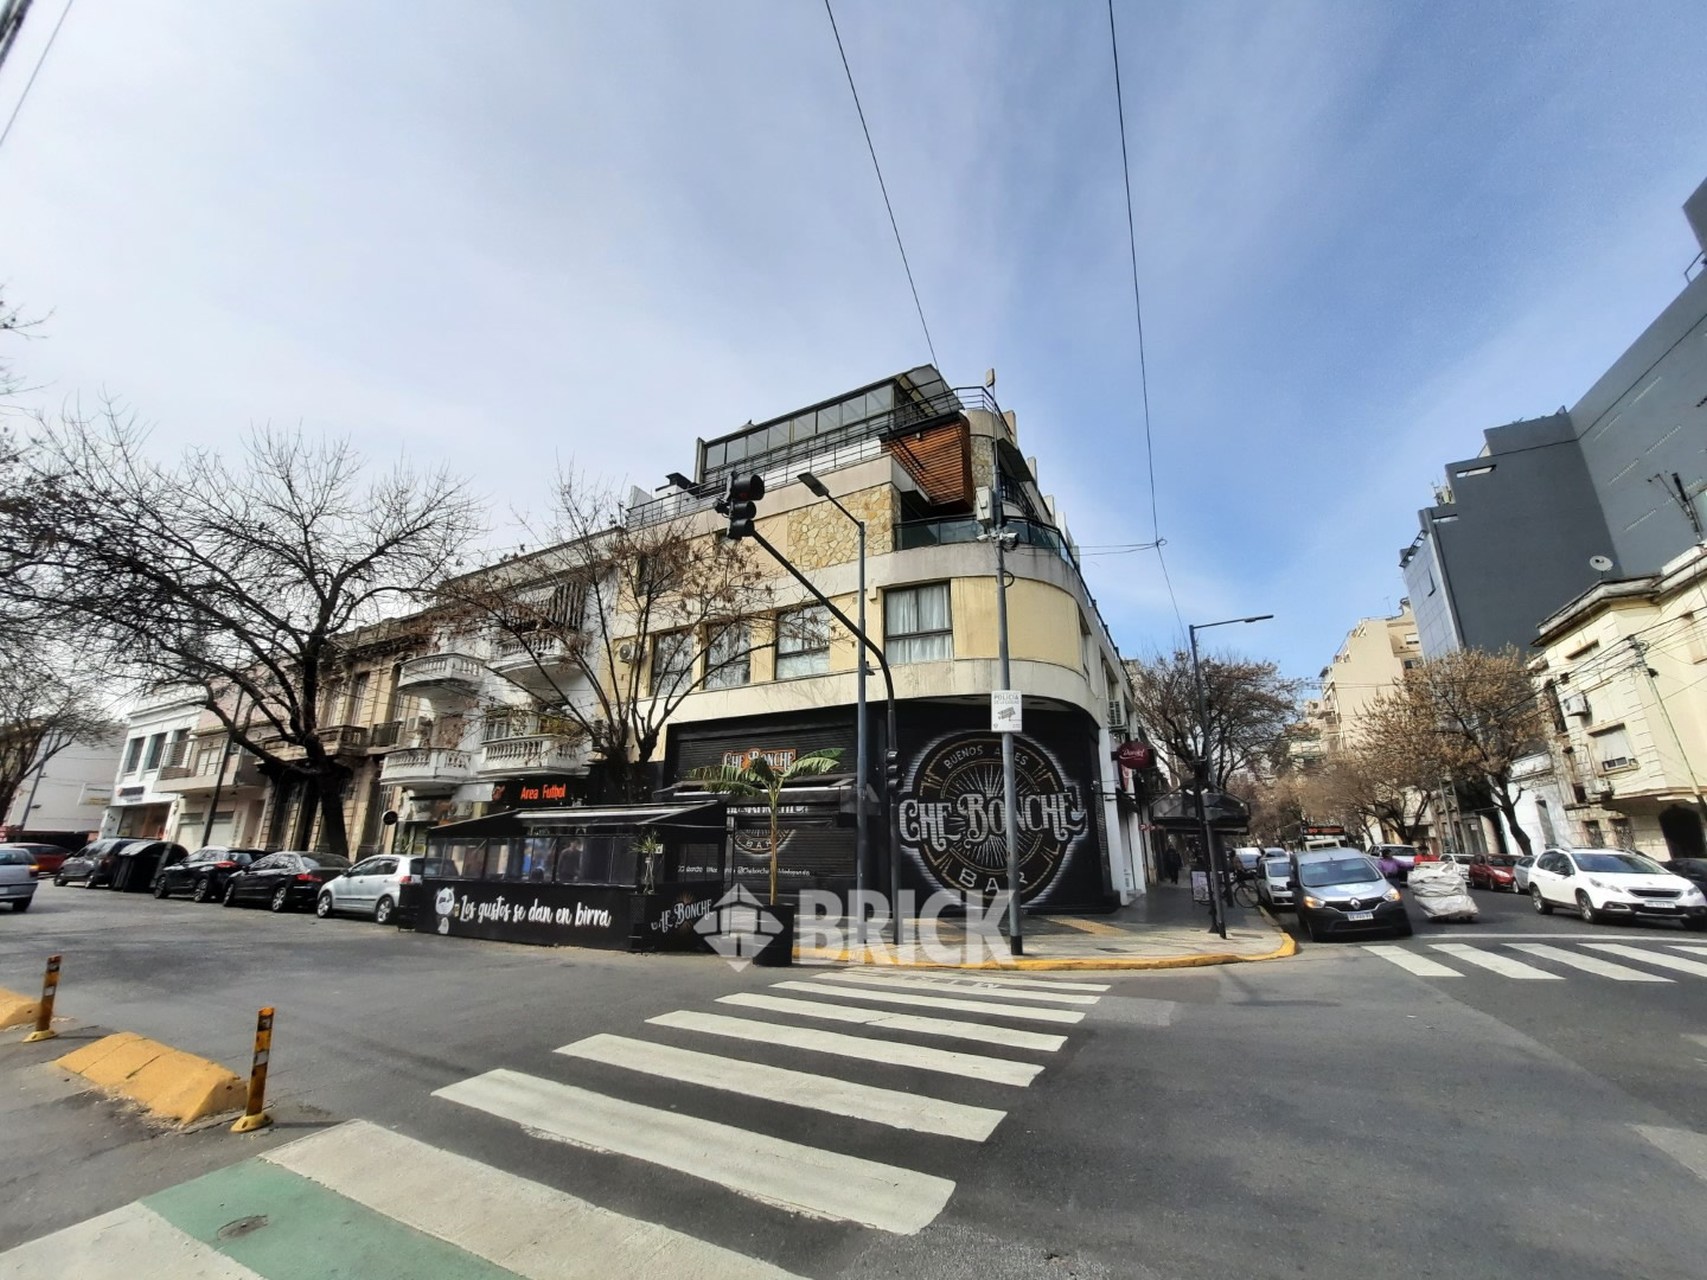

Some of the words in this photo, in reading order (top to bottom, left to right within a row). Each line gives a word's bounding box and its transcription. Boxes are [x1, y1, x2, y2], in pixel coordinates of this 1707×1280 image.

[748, 750, 795, 772] BNCHE
[944, 745, 984, 770] BUENOS
[994, 747, 1029, 766] AES
[520, 786, 539, 800] Area
[542, 783, 567, 799] Futbol
[899, 798, 961, 852] CHE
[460, 894, 476, 922] Los
[478, 896, 512, 923] gustos
[513, 904, 526, 923] se
[528, 899, 552, 923] dan
[555, 907, 572, 924] en
[575, 902, 611, 927] birra
[673, 899, 712, 928] BONCHE
